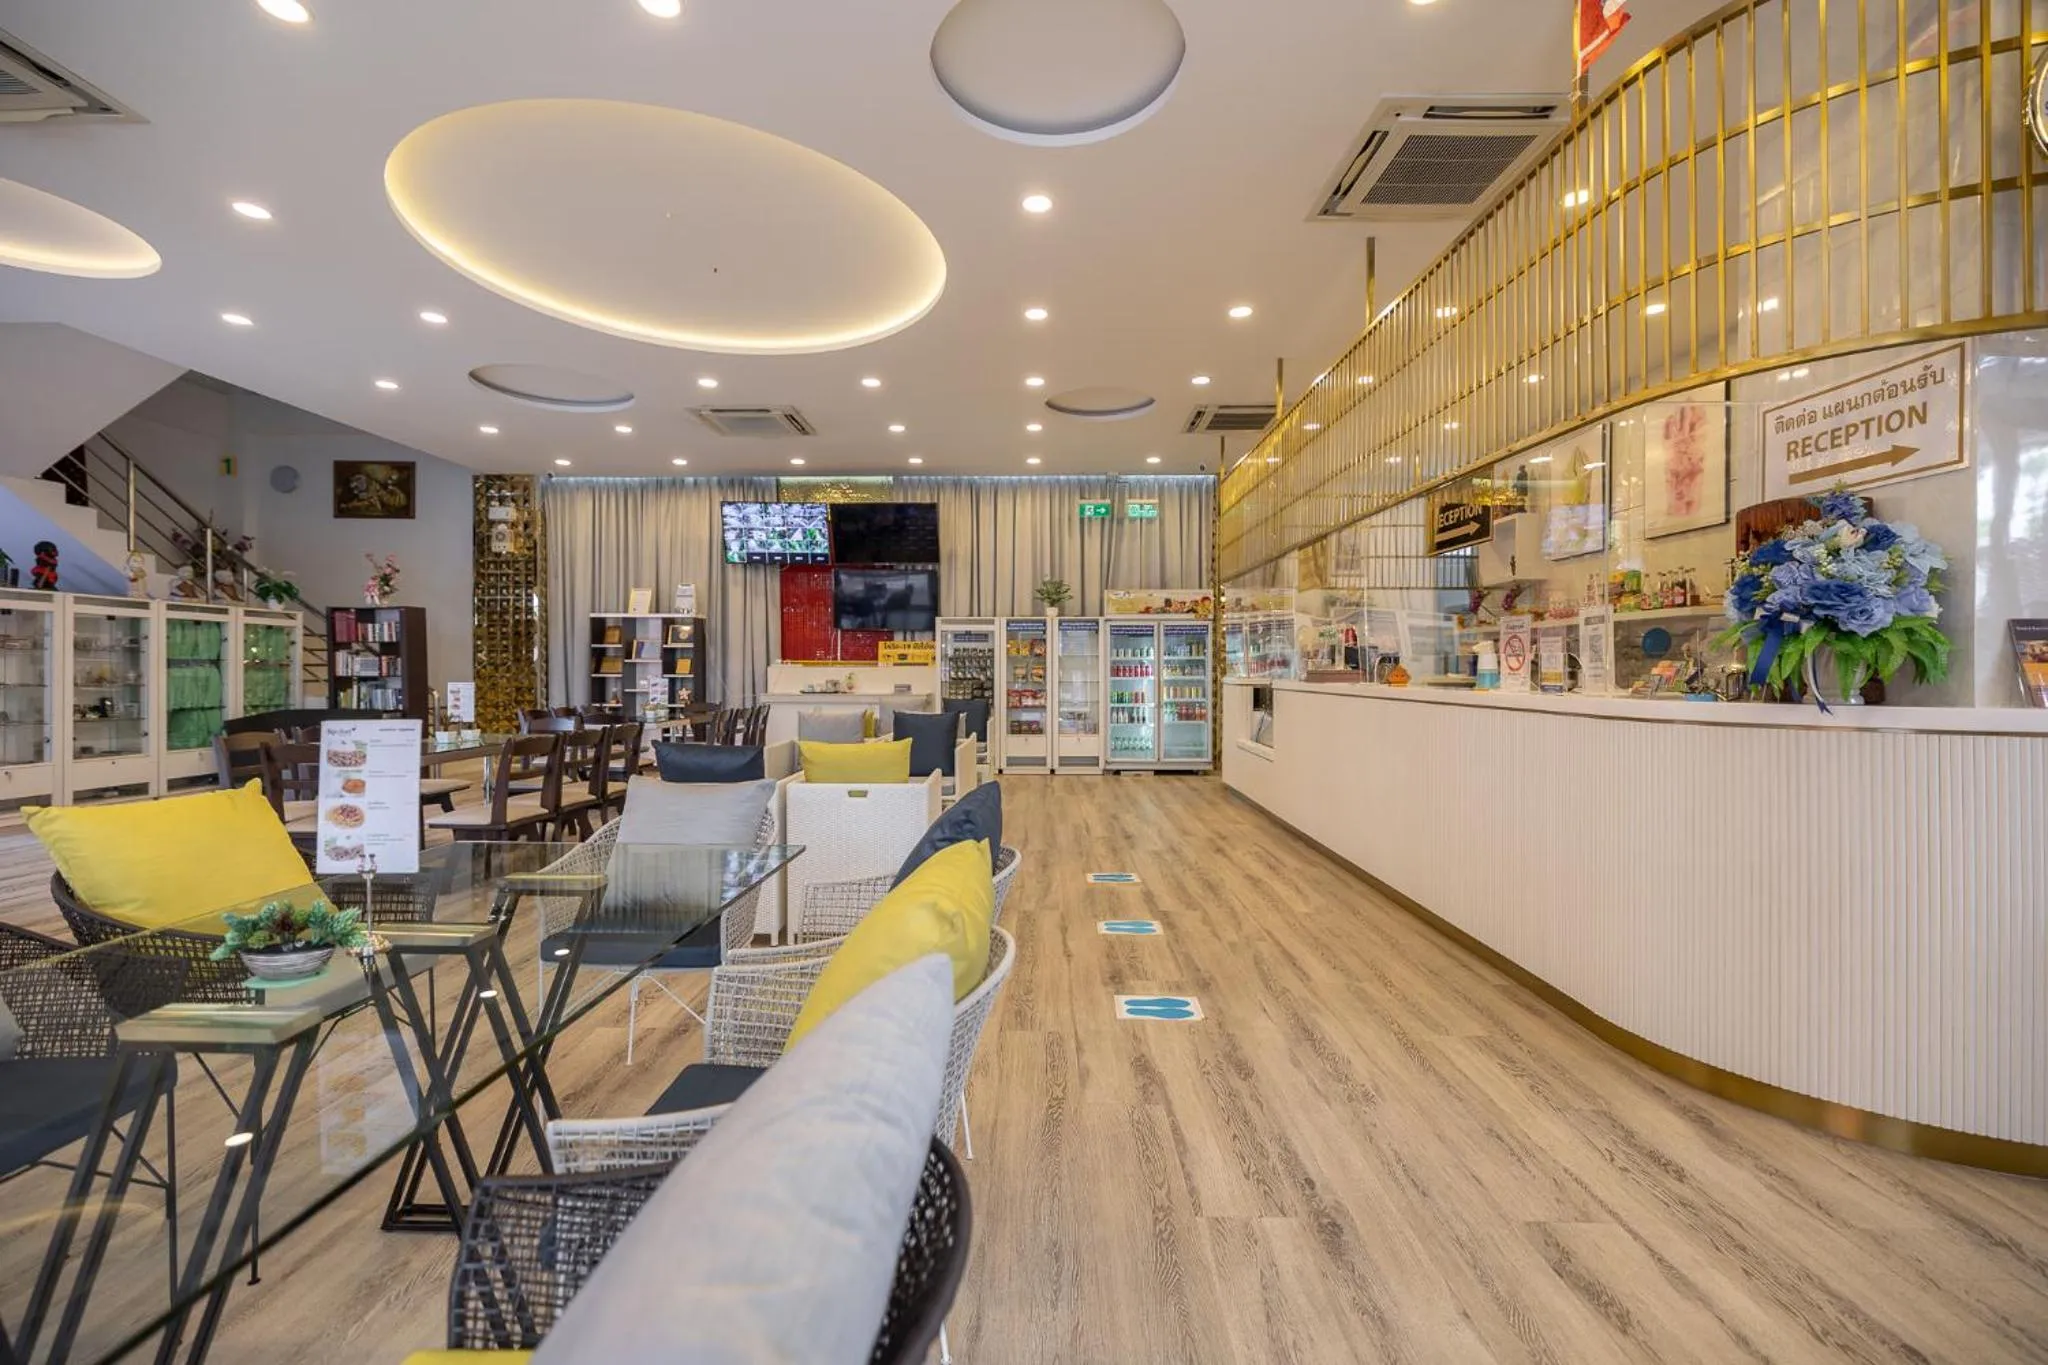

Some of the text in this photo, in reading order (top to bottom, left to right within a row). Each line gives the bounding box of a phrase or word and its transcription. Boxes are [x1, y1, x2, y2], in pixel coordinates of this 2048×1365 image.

[1773, 408, 1818, 435] ติดต่อ
[1786, 401, 1928, 462] RECEPTION
[1437, 503, 1482, 528] ECEPTION
